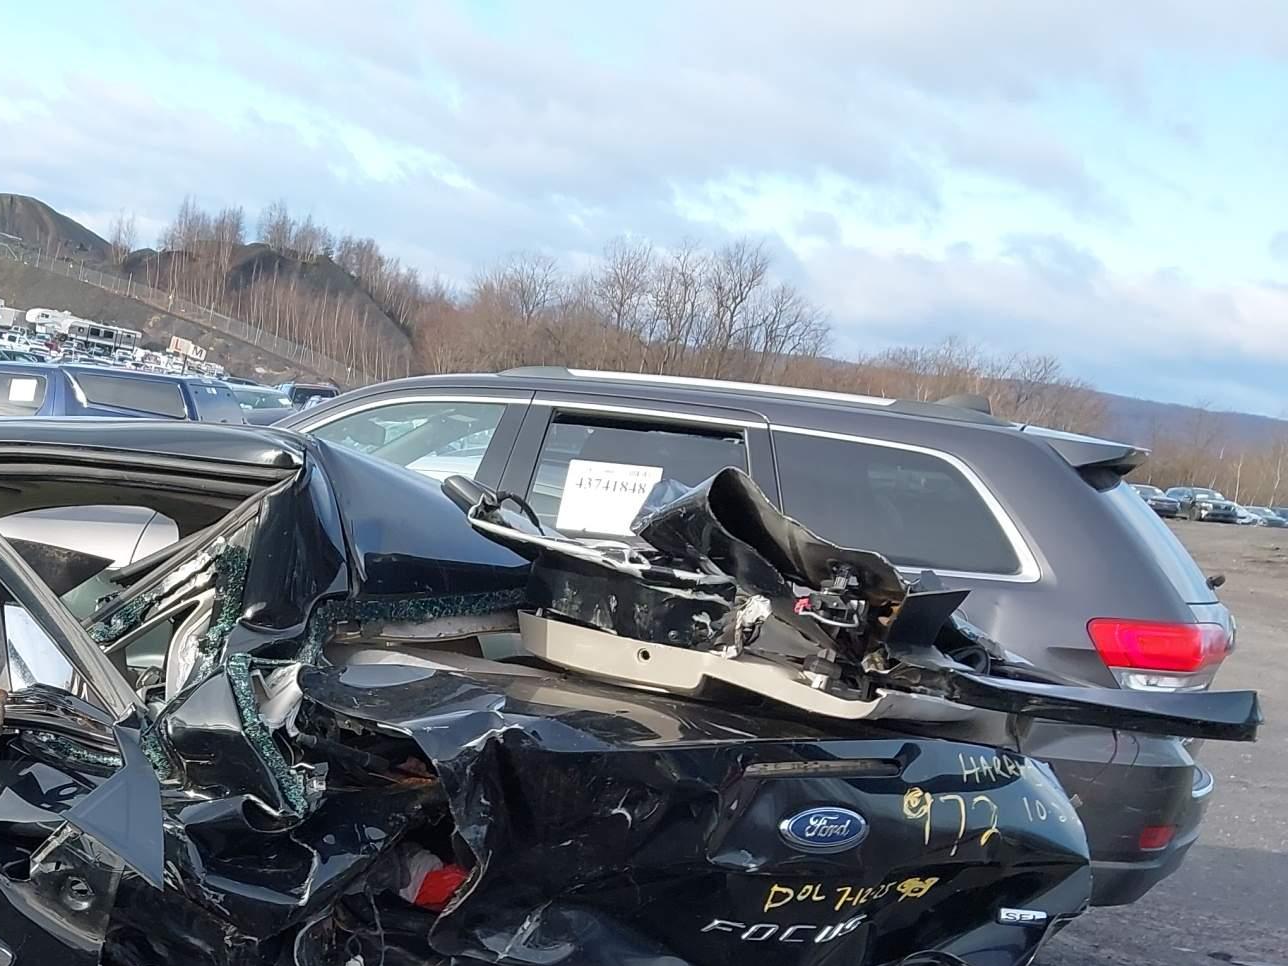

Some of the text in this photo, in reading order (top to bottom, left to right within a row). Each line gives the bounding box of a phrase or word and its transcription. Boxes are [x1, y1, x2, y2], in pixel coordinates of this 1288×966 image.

[192, 346, 204, 358] M
[804, 813, 851, 838] Ford
[764, 884, 826, 913] DOL
[700, 914, 868, 944] FOCUS
